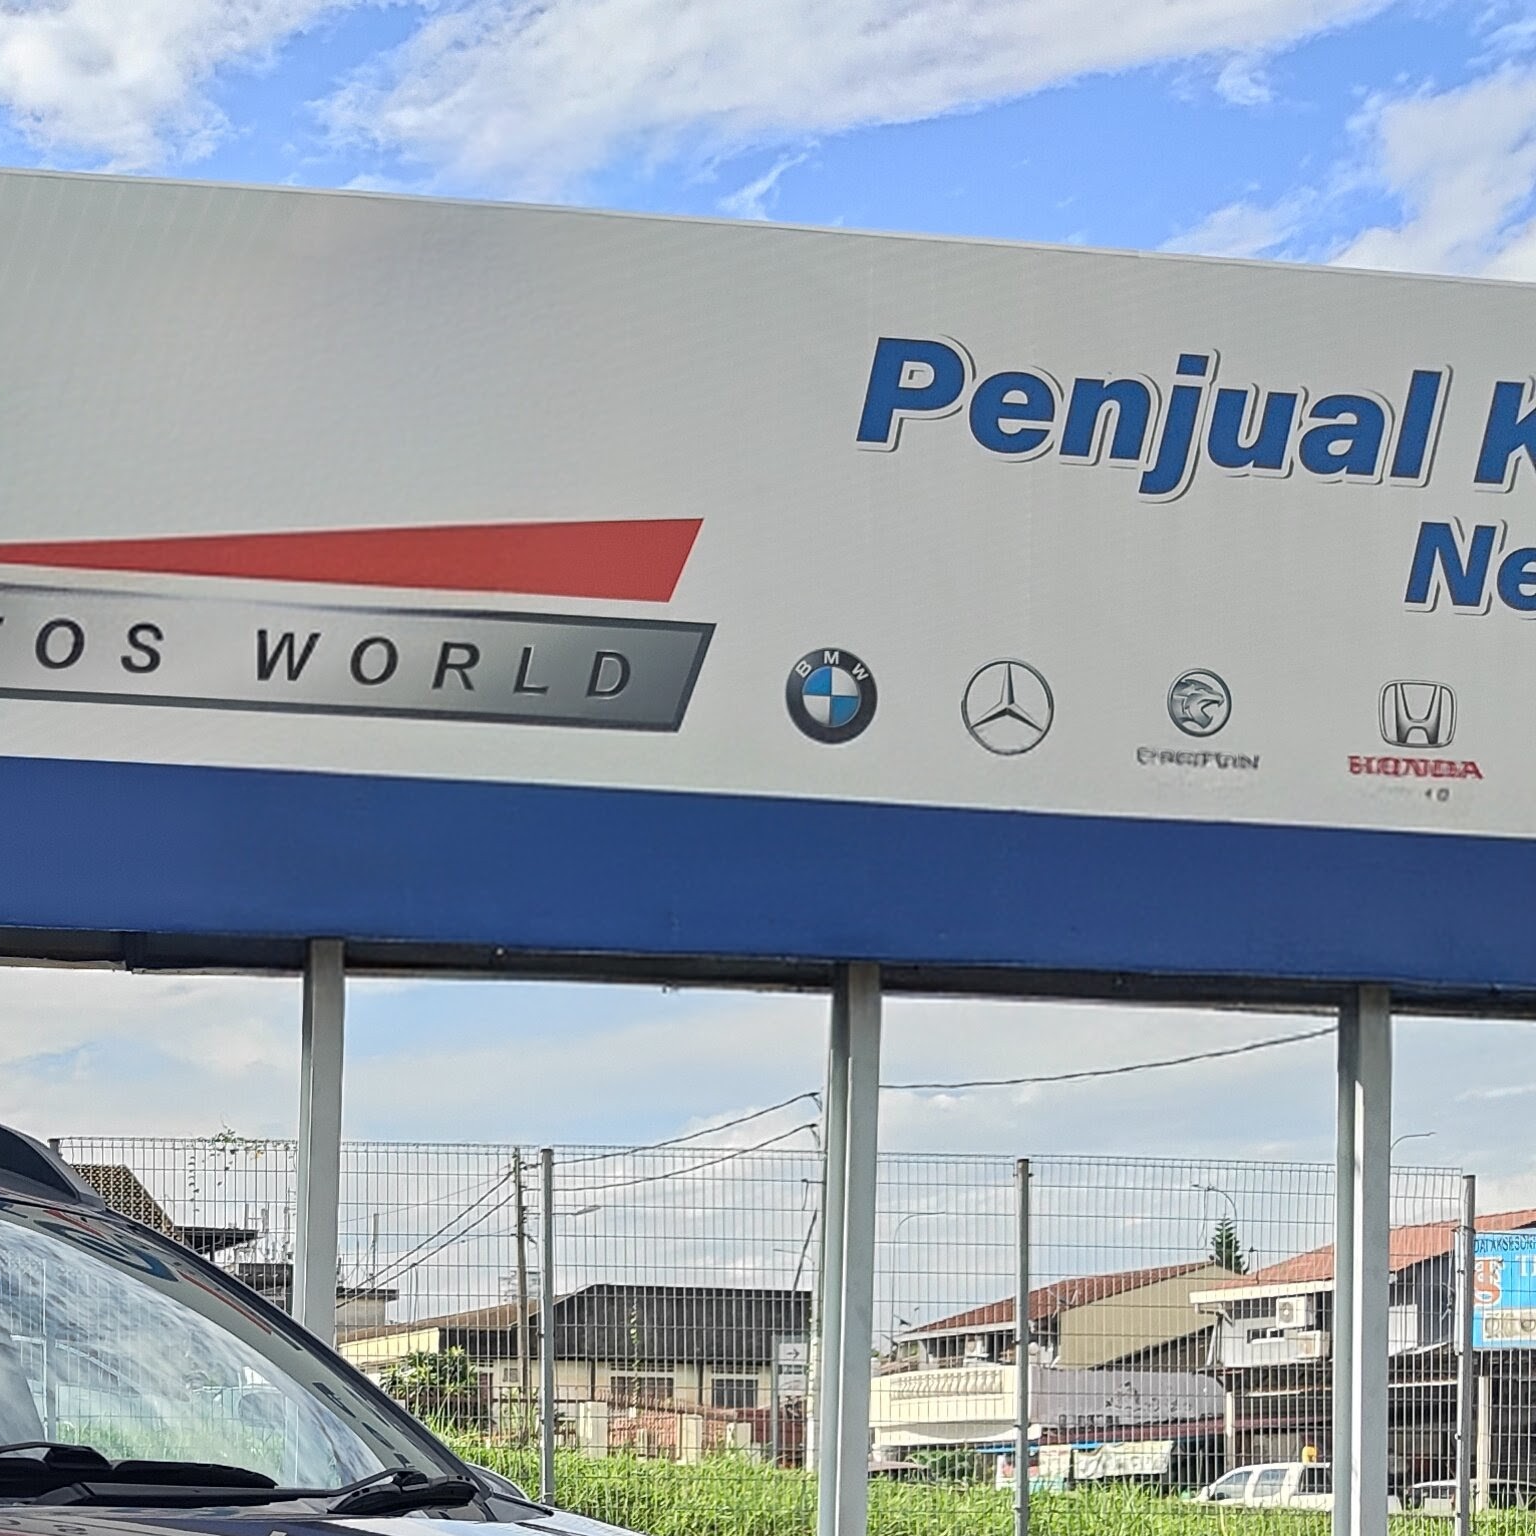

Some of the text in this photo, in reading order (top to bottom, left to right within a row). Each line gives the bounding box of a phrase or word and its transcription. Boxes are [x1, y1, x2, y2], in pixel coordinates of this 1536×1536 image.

[855, 335, 1446, 497] Penjual
[255, 629, 632, 700] WORLD
[795, 650, 869, 681] BMW
[1347, 755, 1483, 780] HONDA
